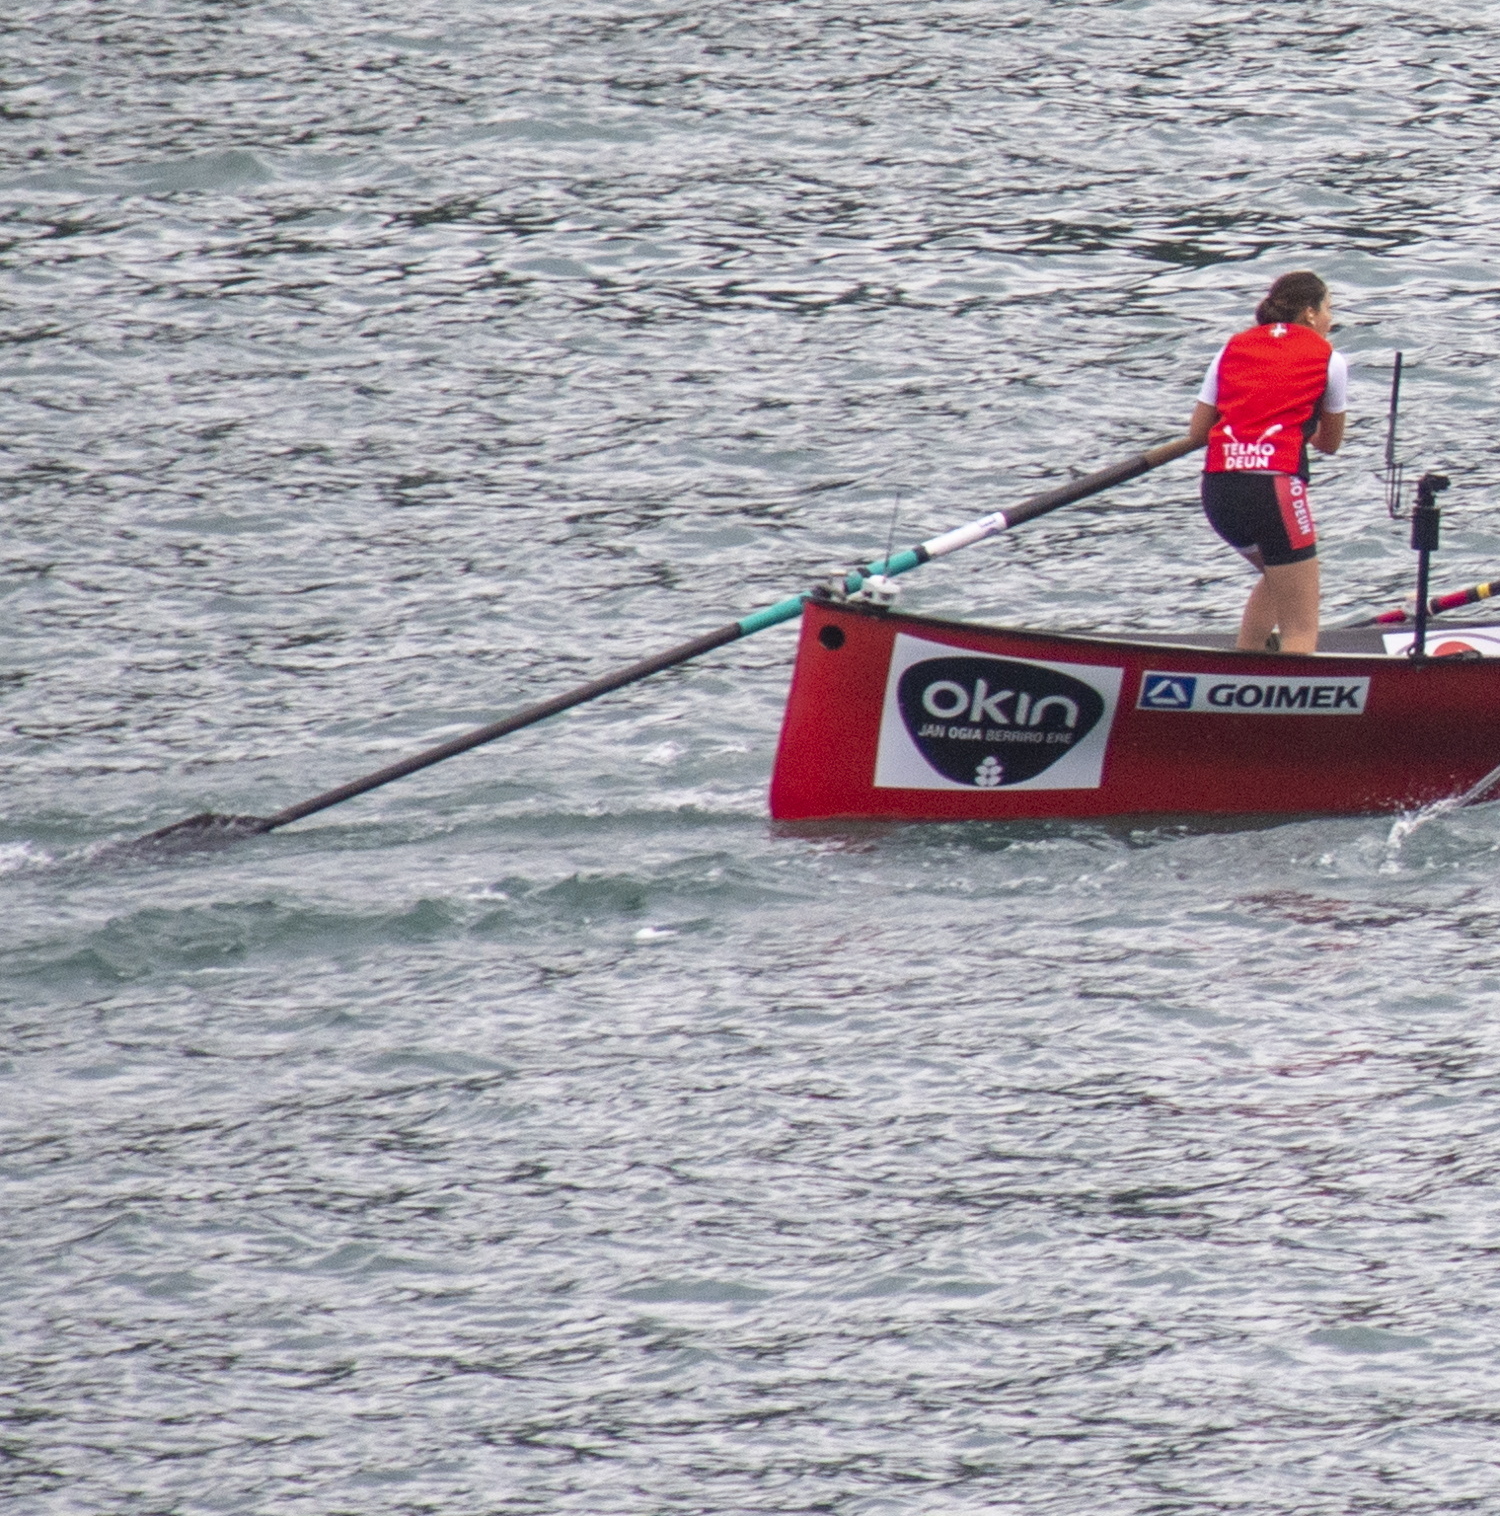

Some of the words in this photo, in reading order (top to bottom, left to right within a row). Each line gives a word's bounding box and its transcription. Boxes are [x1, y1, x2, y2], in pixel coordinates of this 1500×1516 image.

[1222, 443, 1275, 456] TELMO
[1225, 456, 1269, 470] DEUN
[1292, 499, 1312, 535] DEUN
[1206, 683, 1361, 709] GOIMEK
[918, 723, 946, 738] JAN
[948, 726, 983, 741] OGIA
